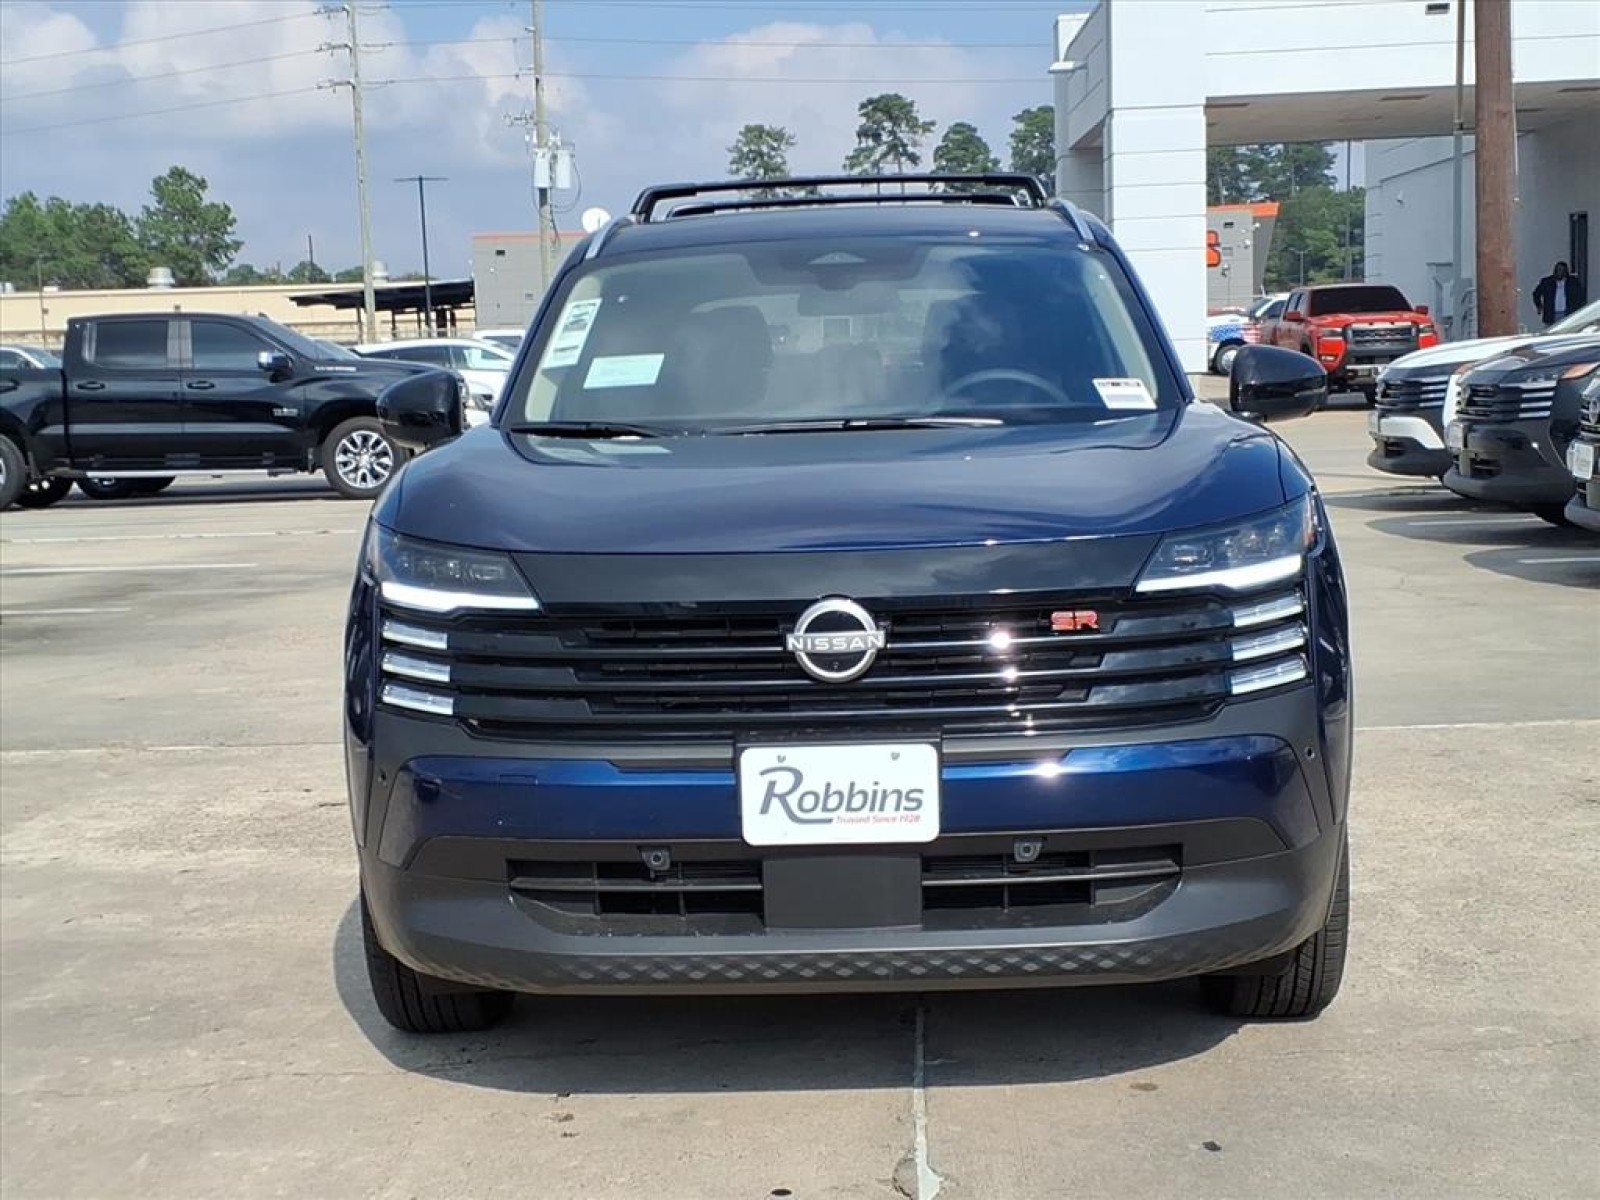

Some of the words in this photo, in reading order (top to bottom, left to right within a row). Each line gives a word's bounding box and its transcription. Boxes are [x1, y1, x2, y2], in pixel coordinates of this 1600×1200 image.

[1051, 610, 1099, 630] SR
[787, 635, 884, 651] NISSAN
[759, 766, 925, 825] Robbins
